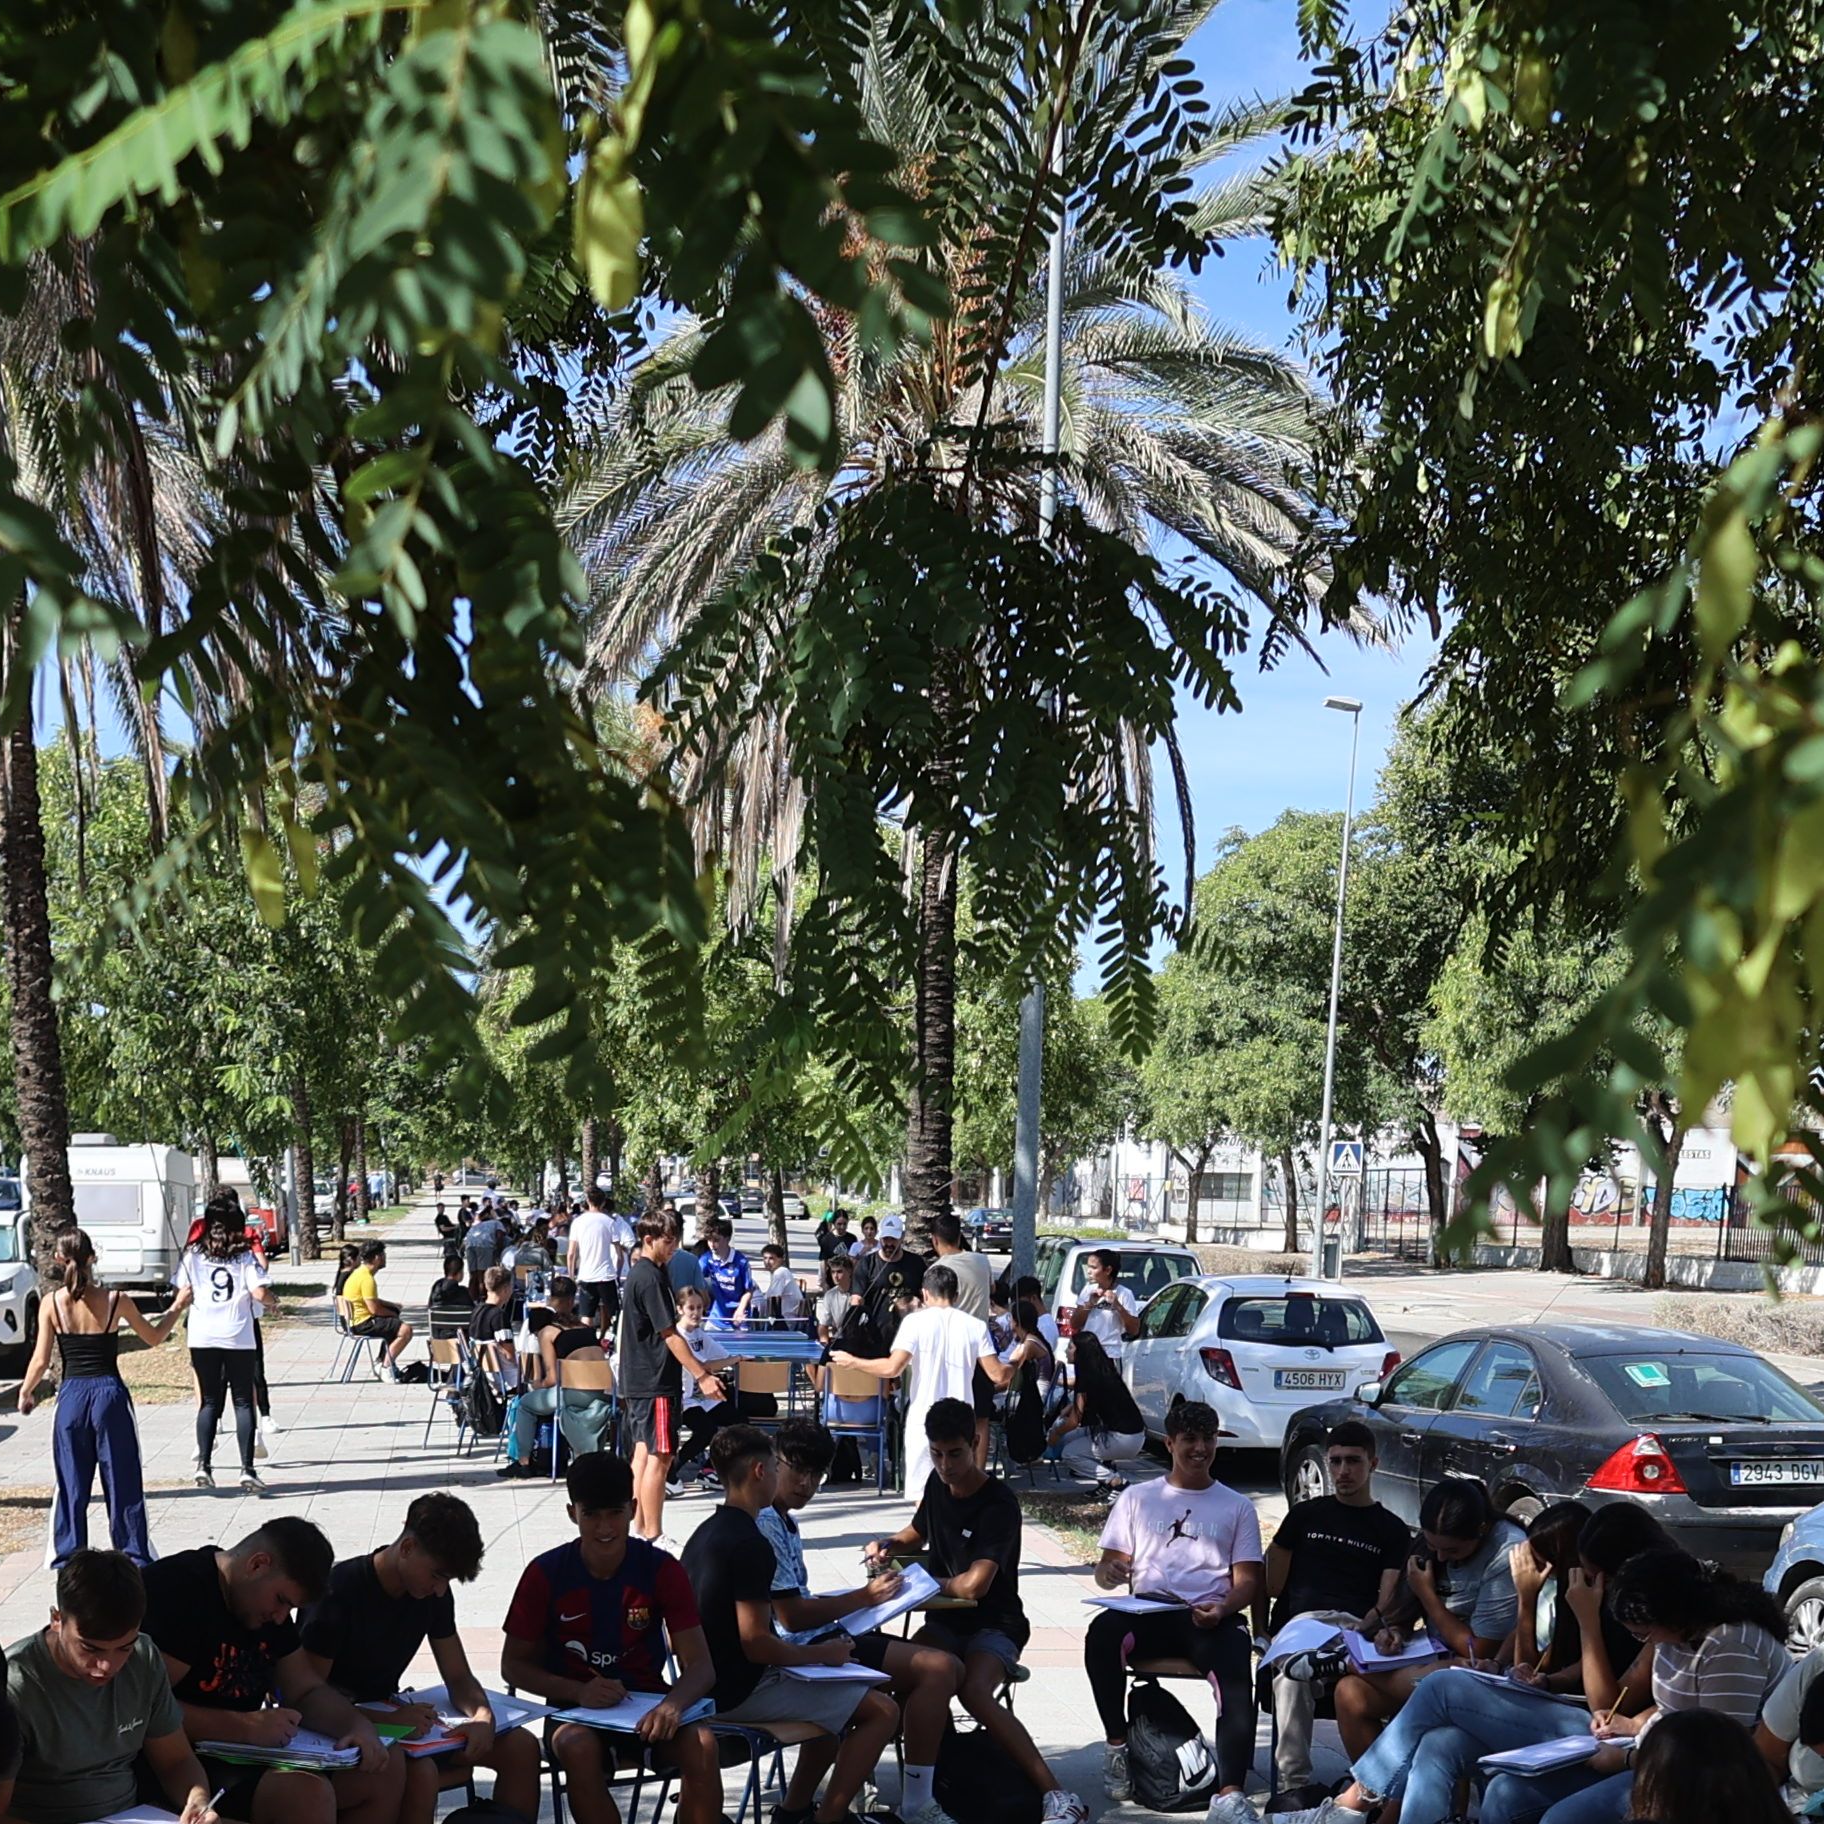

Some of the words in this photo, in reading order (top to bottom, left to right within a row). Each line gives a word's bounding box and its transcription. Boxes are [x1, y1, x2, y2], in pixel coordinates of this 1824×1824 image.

[84, 1167, 116, 1176] KNAUS
[211, 1266, 234, 1303] 9
[1285, 1372, 1315, 1385] 4506
[1319, 1373, 1341, 1386] HYX
[1744, 1463, 1783, 1481] 2943
[1791, 1463, 1819, 1481] DGV
[1307, 1532, 1338, 1542] TOMMY
